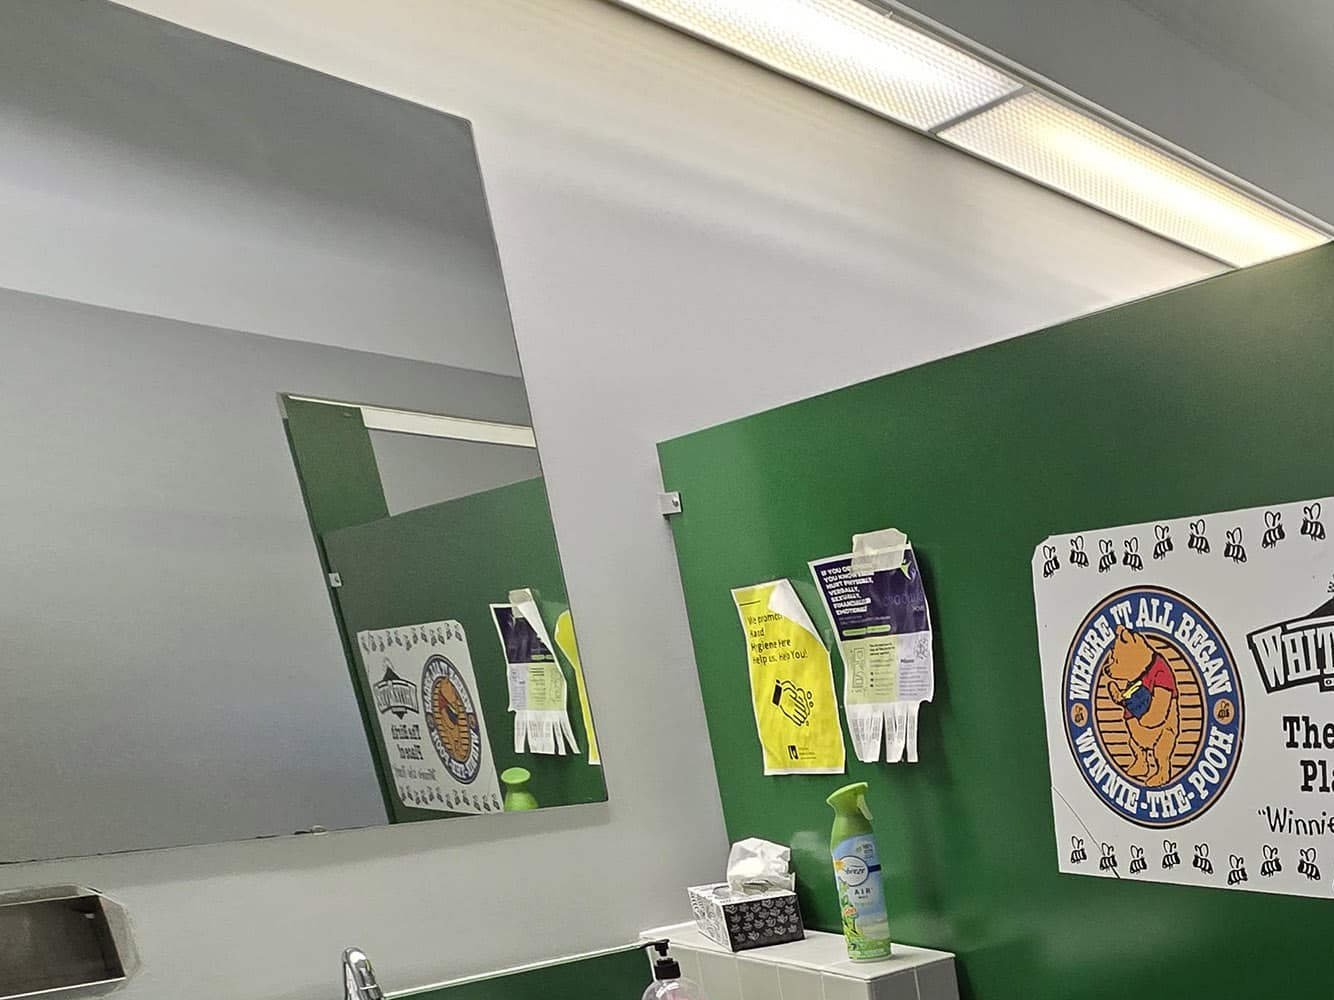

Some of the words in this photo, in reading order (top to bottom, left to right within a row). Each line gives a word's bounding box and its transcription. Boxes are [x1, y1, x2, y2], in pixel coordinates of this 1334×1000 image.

[1069, 614, 1117, 700] WHERE
[1109, 601, 1134, 630] IT
[1135, 598, 1176, 634] ALL
[1174, 611, 1233, 696] BEGAN
